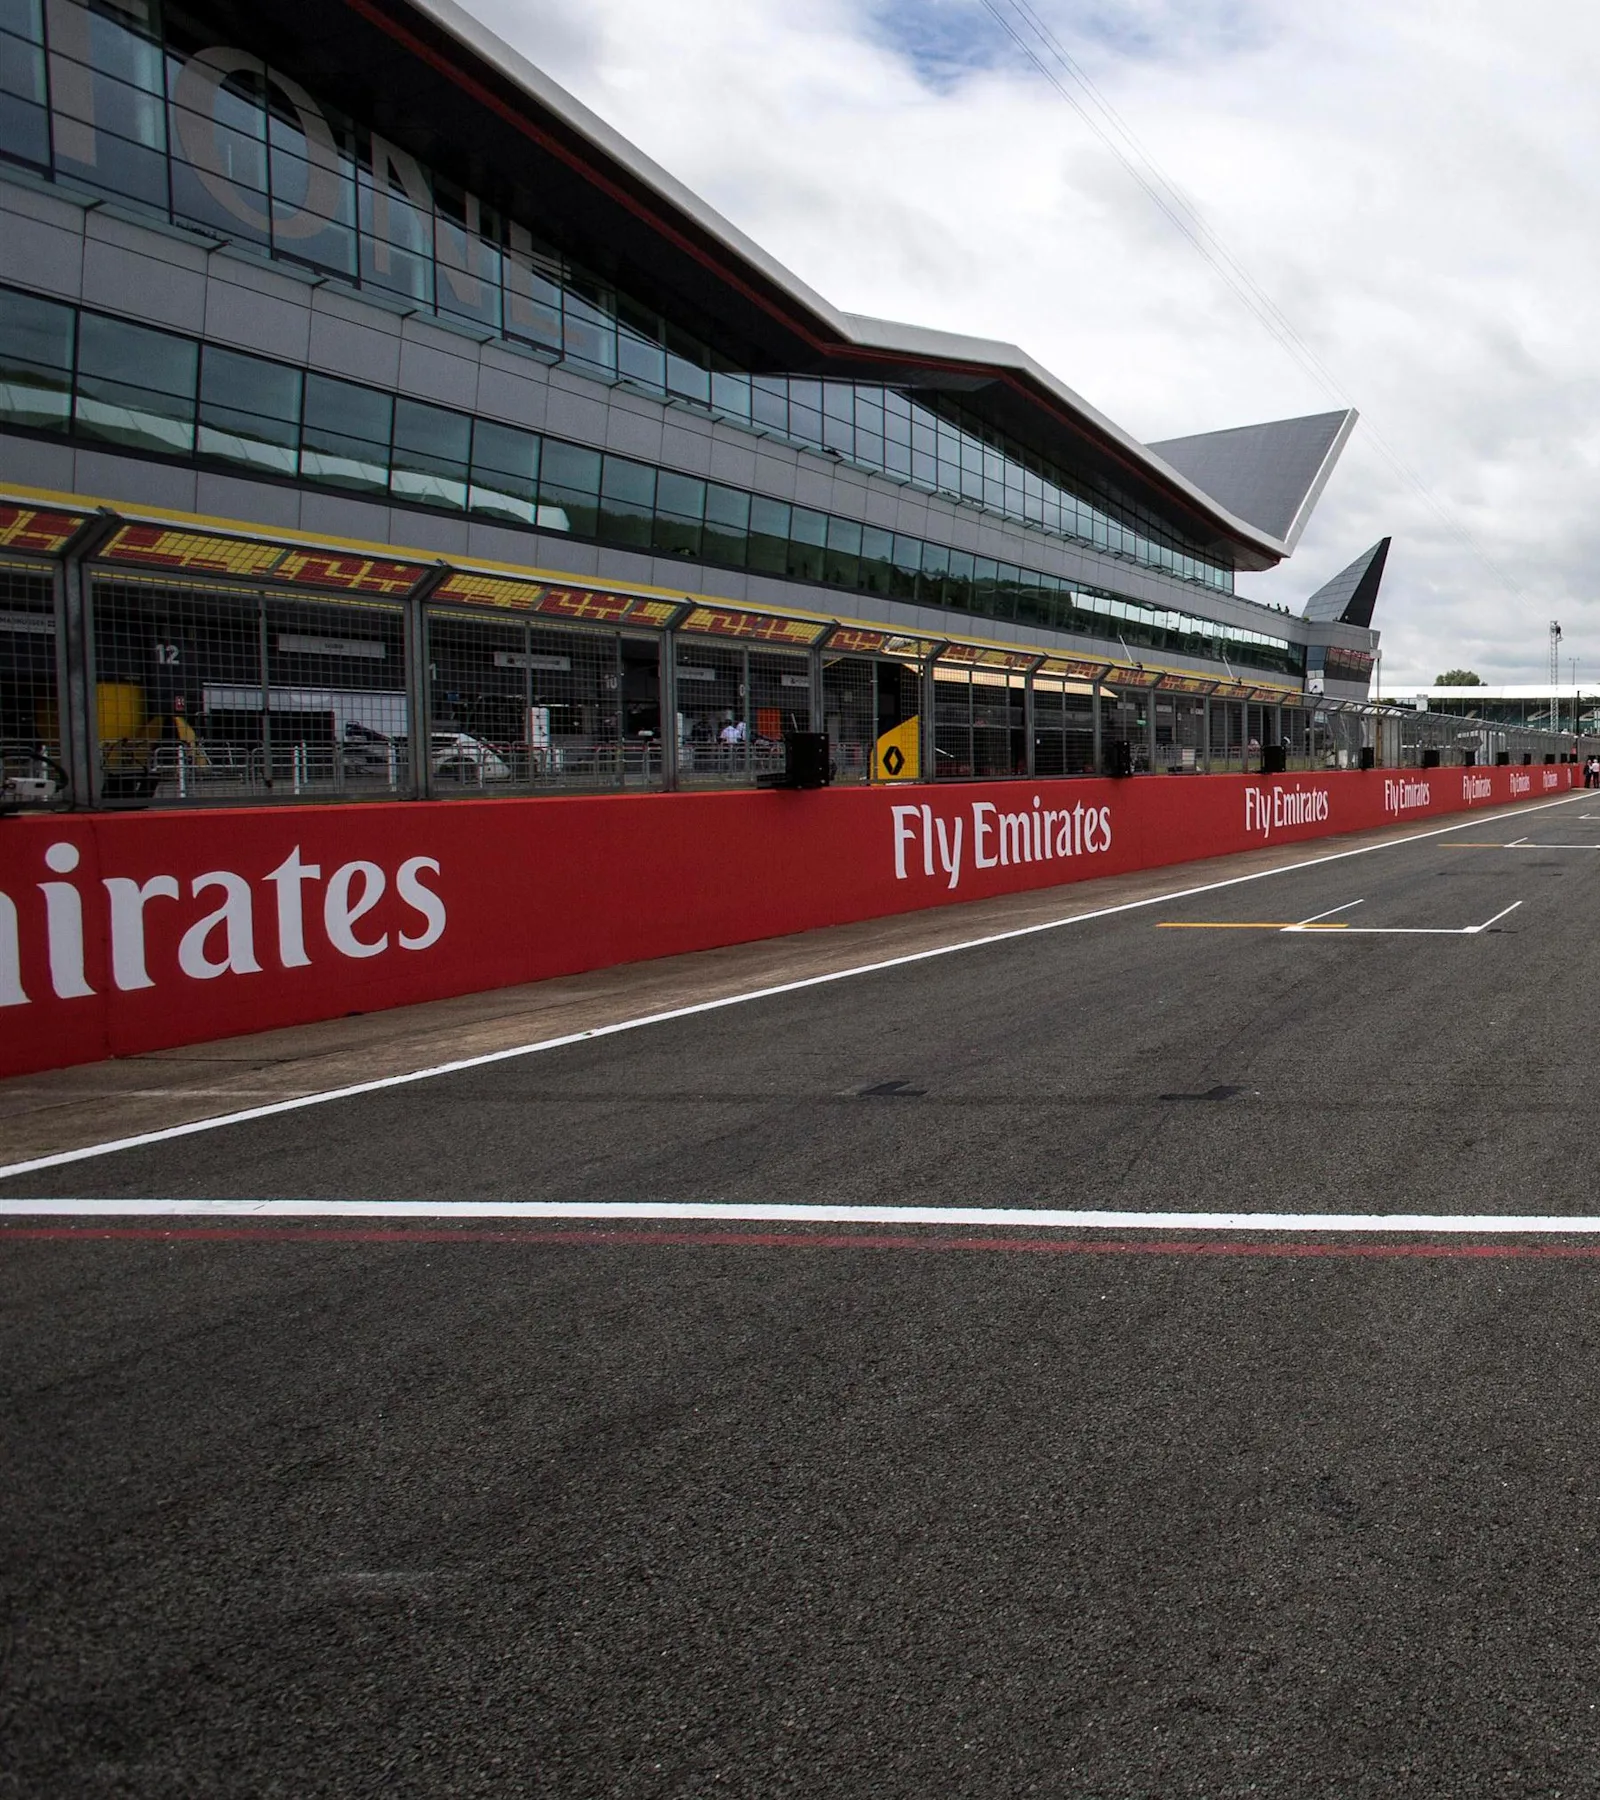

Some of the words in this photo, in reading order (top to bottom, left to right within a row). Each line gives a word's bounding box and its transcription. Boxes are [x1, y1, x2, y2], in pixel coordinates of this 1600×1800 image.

[155, 643, 180, 665] 12
[1245, 787, 1271, 838] Fly
[1273, 784, 1329, 827] Emirates
[1384, 780, 1399, 816] Fly
[1399, 778, 1430, 808] Emirates
[891, 805, 963, 889] Fly
[972, 796, 1112, 869] Emirates
